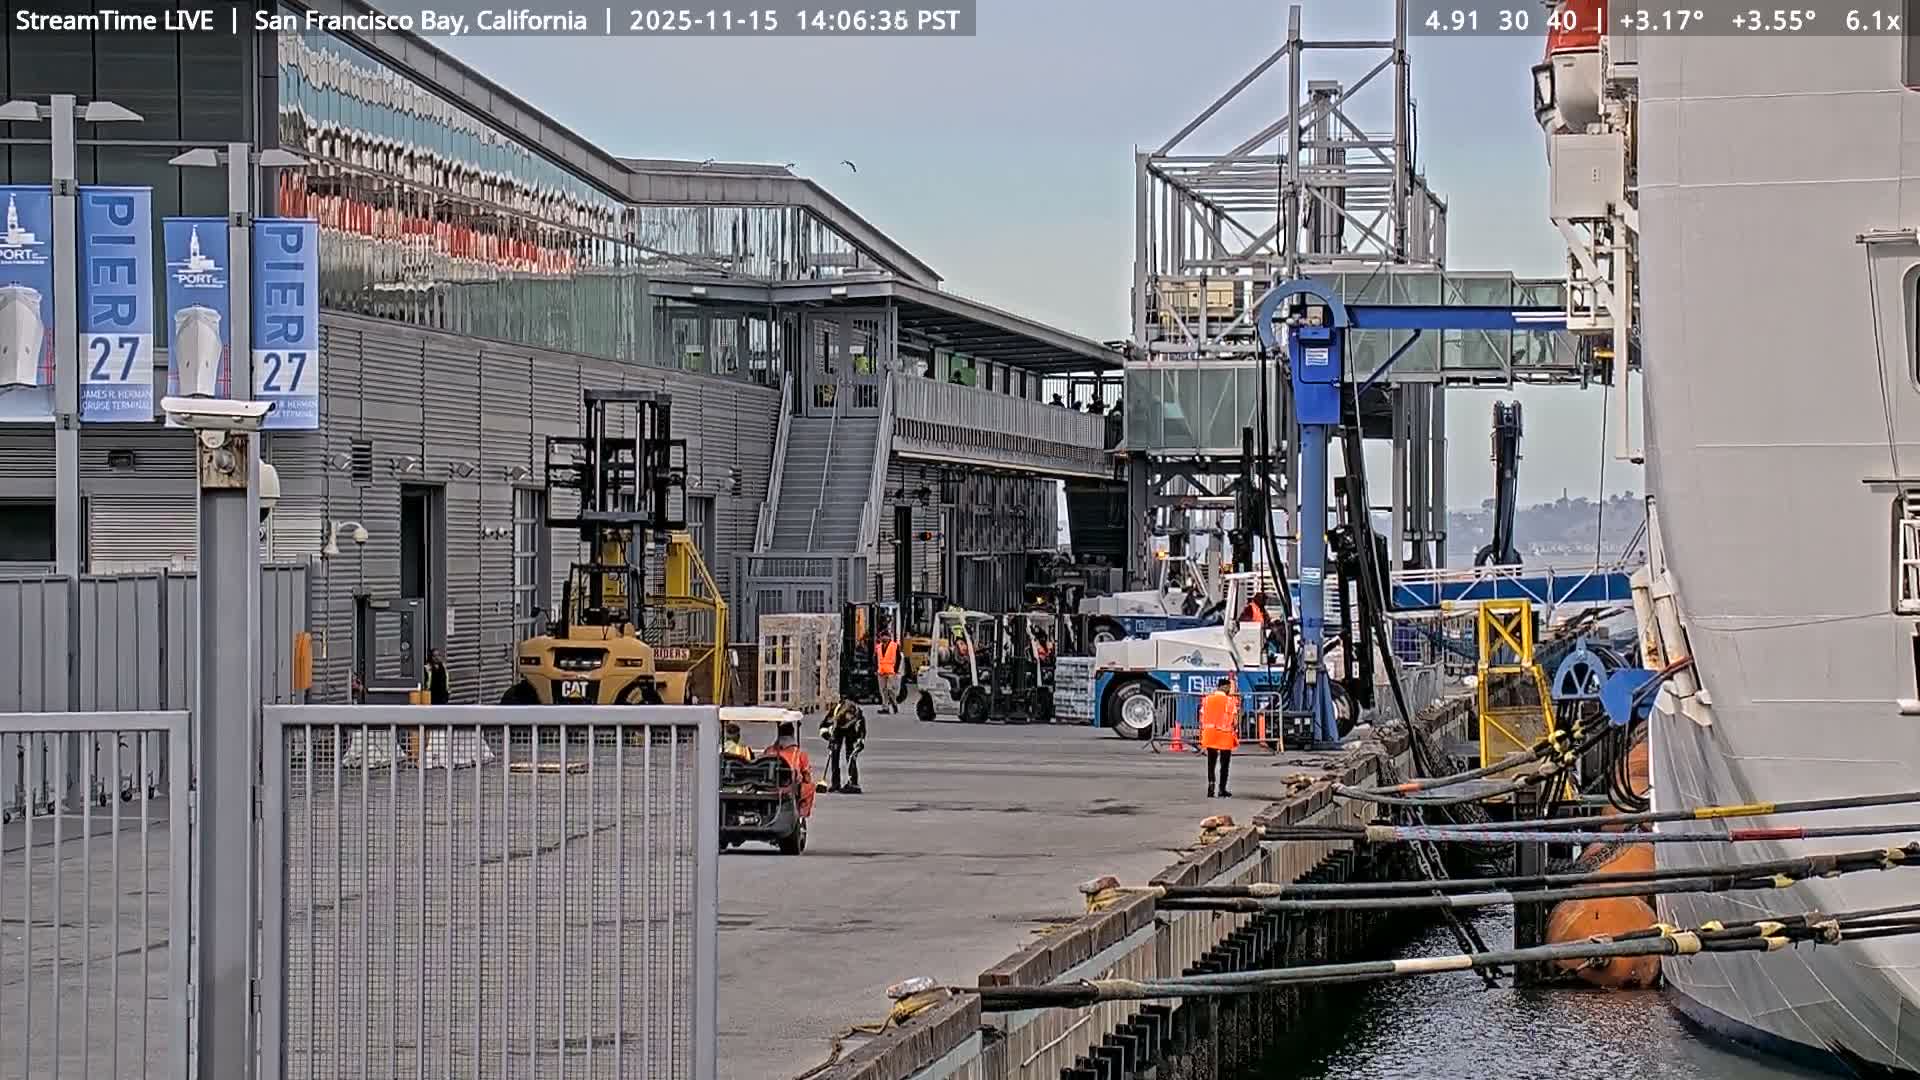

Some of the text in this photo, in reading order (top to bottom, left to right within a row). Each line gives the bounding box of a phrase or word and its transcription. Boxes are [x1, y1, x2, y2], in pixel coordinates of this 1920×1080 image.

[90, 194, 137, 328] PIER
[177, 273, 213, 284] PORT
[263, 225, 305, 344] PIER
[89, 336, 140, 382] 27
[263, 352, 307, 392] 27
[561, 680, 589, 698] CAT
